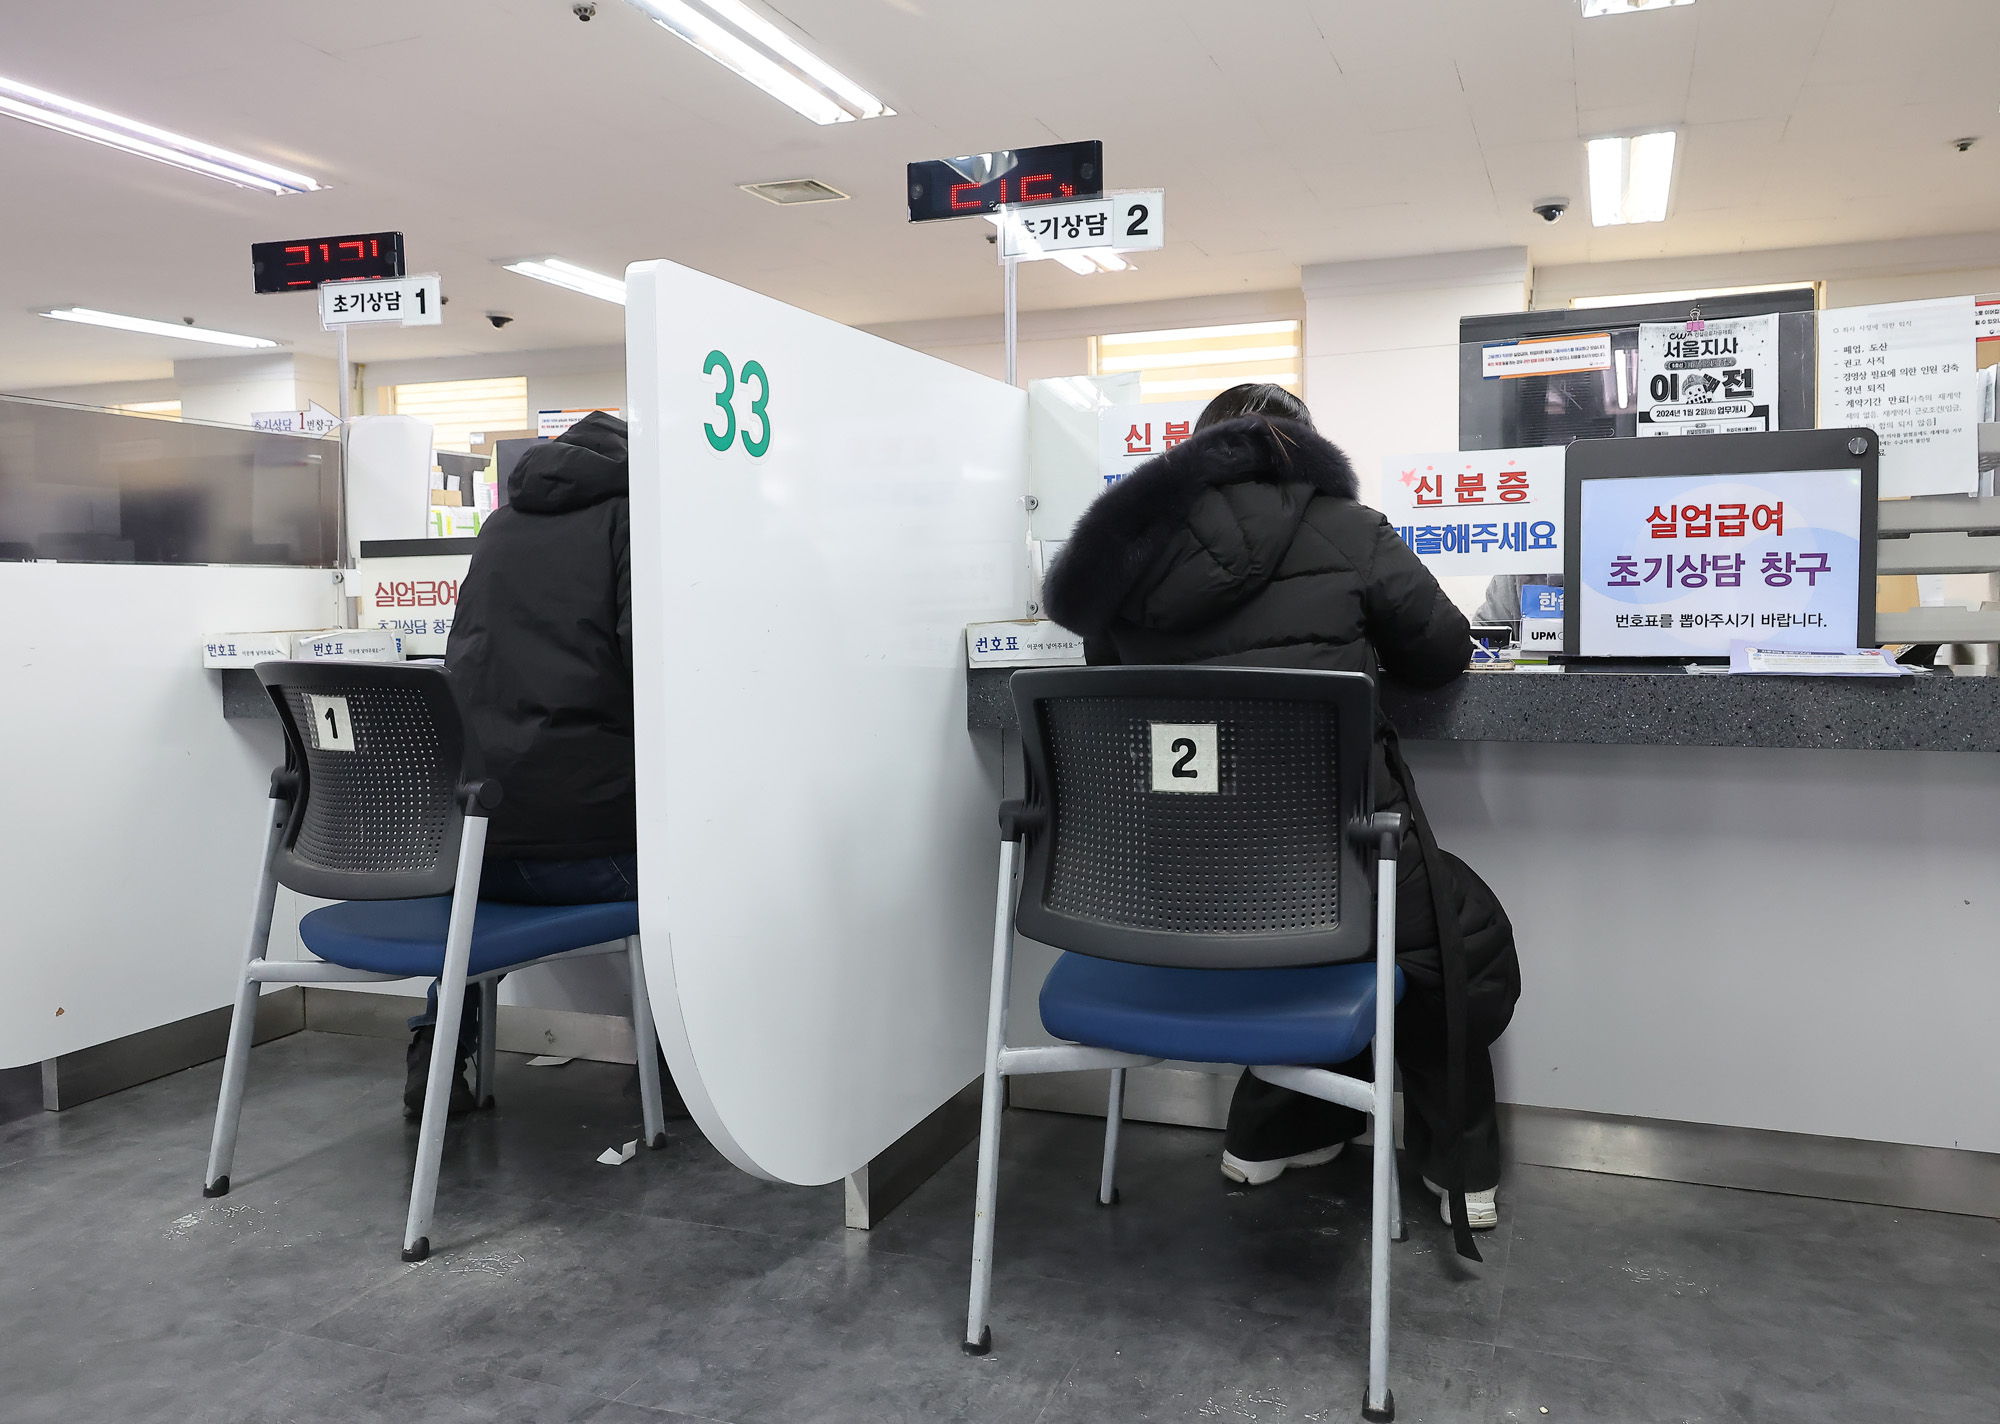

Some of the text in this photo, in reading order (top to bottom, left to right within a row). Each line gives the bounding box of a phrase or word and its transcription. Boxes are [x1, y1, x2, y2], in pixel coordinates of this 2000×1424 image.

[1126, 204, 1149, 235] 2
[333, 288, 426, 314] 초기상담 1
[1664, 337, 1738, 358] 서울지사
[1869, 342, 1888, 352] 도산
[1844, 356, 1885, 368] 권고 사직
[1843, 363, 1959, 382] 경영상 필요에 의한 인원 감축
[1650, 368, 1754, 402] 이 전
[1844, 383, 1885, 395] 정년 퇴직
[703, 350, 770, 457] 33
[1682, 408, 1693, 417] 1월
[1717, 405, 1746, 415] 업무개시
[1846, 397, 1881, 408] 계약기간
[254, 418, 292, 432] 초기상담
[1645, 501, 1784, 539] 실업급여
[1607, 552, 1832, 588] 초기상담 창구
[375, 580, 458, 607] 실업급여
[1615, 613, 1827, 629] 번호표를 뽑아주시기 바랍니다.
[976, 636, 1020, 653] 번호표
[1531, 631, 1556, 640] UPM
[207, 644, 237, 657] 번호표
[314, 643, 344, 657] 번호표
[325, 707, 338, 739] 1
[1171, 737, 1198, 779] 2
